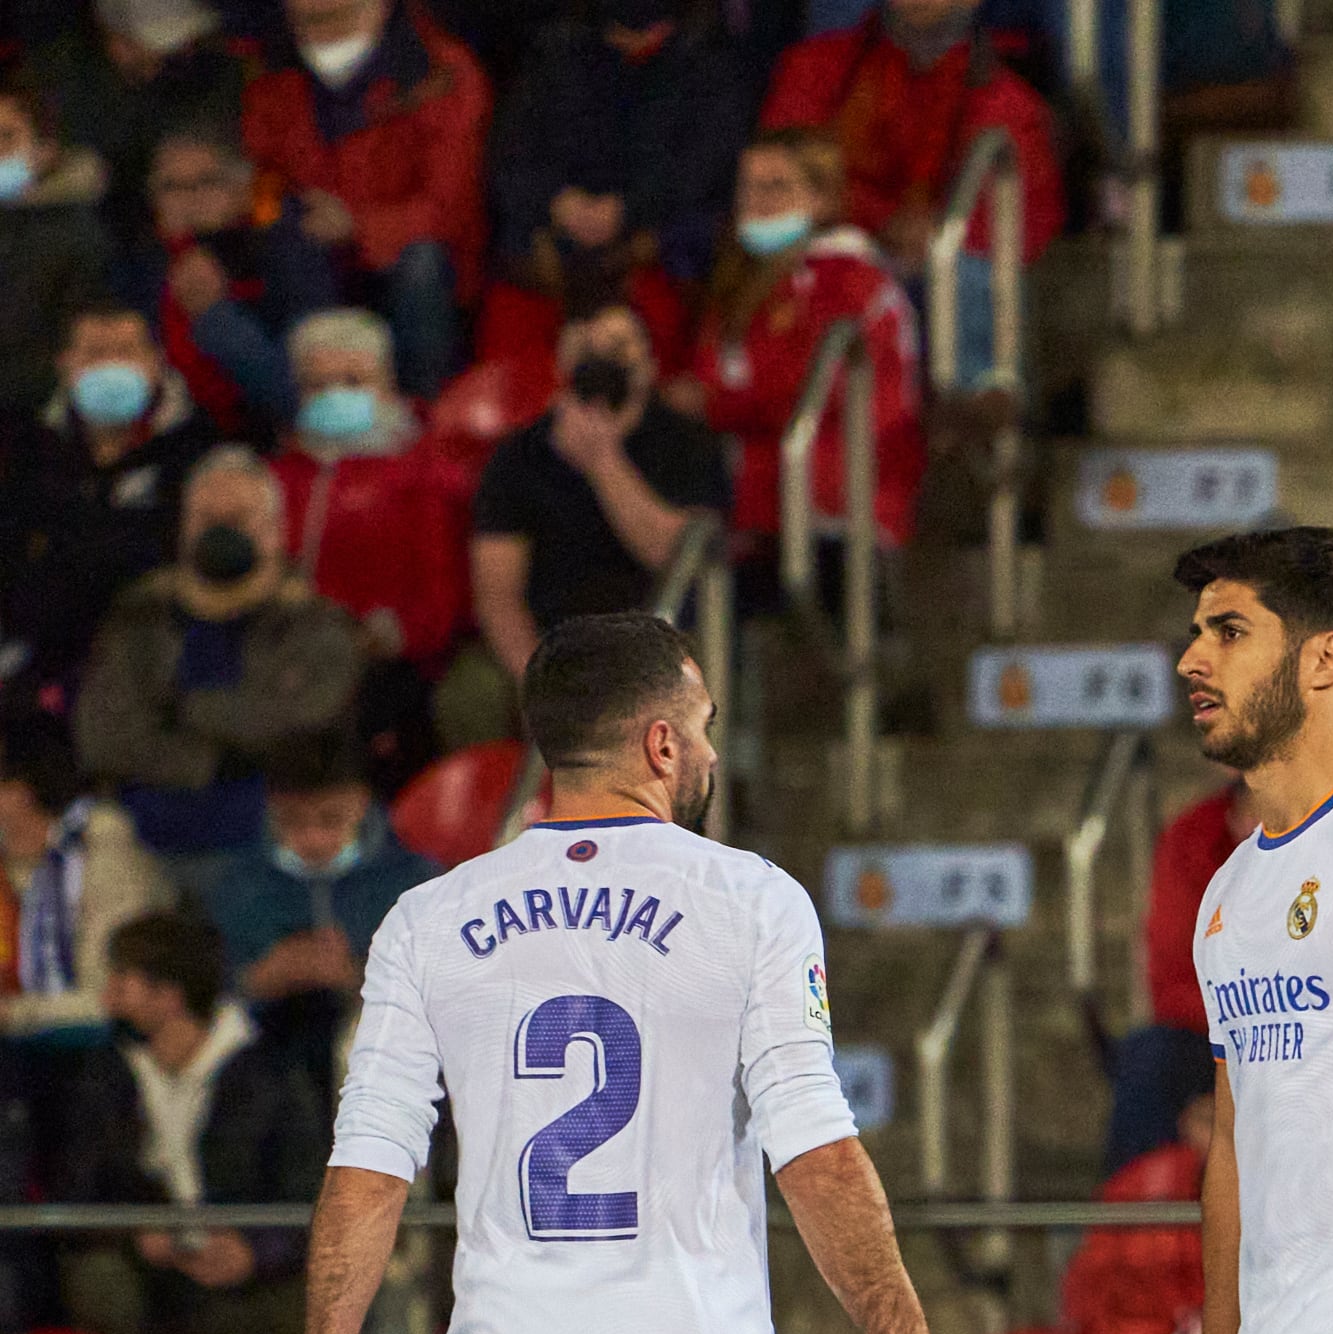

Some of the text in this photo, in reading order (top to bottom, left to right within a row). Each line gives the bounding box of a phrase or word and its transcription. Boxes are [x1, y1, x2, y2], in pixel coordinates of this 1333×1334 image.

[460, 886, 684, 956] CARVAJAL
[1206, 967, 1330, 1024] mirates
[1248, 1022, 1304, 1063] BETTER
[514, 995, 642, 1242] 2
